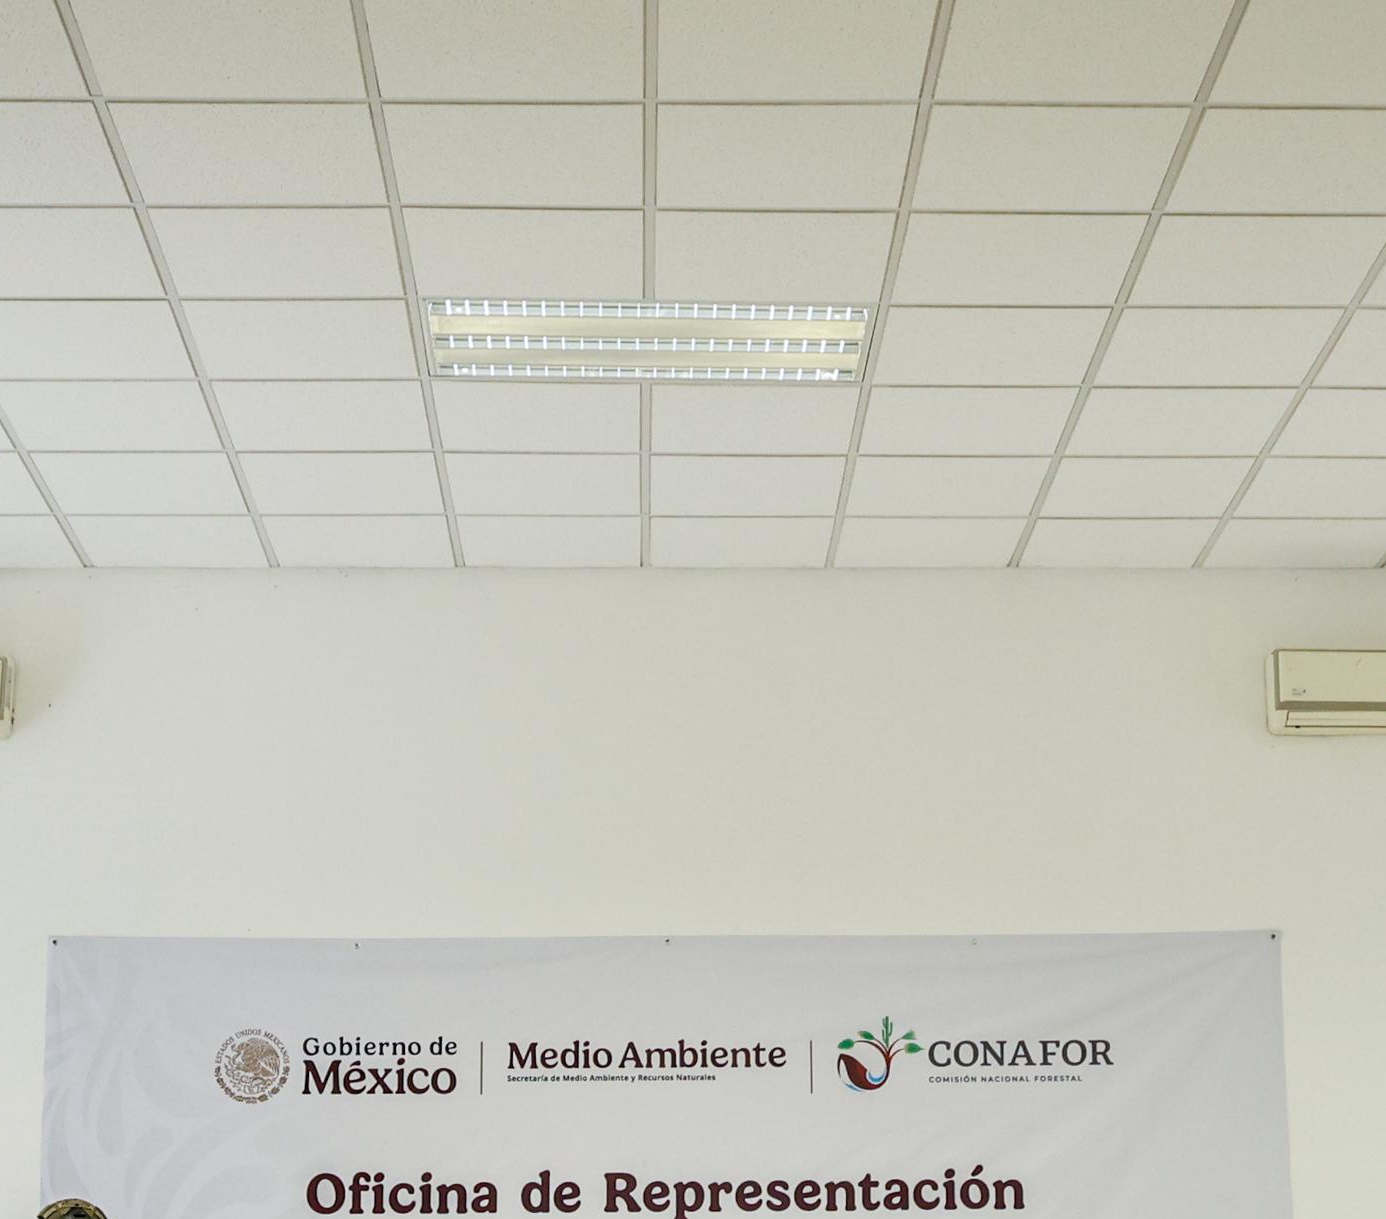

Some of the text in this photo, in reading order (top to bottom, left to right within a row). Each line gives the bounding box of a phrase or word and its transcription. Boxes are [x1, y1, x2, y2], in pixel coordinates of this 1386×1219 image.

[302, 1036, 458, 1057] Gobierno de
[507, 1038, 787, 1070] Medio Ambiente
[928, 1039, 1114, 1068] CONAFOR
[301, 1058, 457, 1095] México
[506, 1073, 717, 1084] Secretaría de Medio Ambiente y Recursos Naturales
[928, 1074, 1083, 1084] COMISIÓN NACIONAL FORESTAL
[306, 1171, 498, 1215] Oficina
[521, 1169, 582, 1214] de
